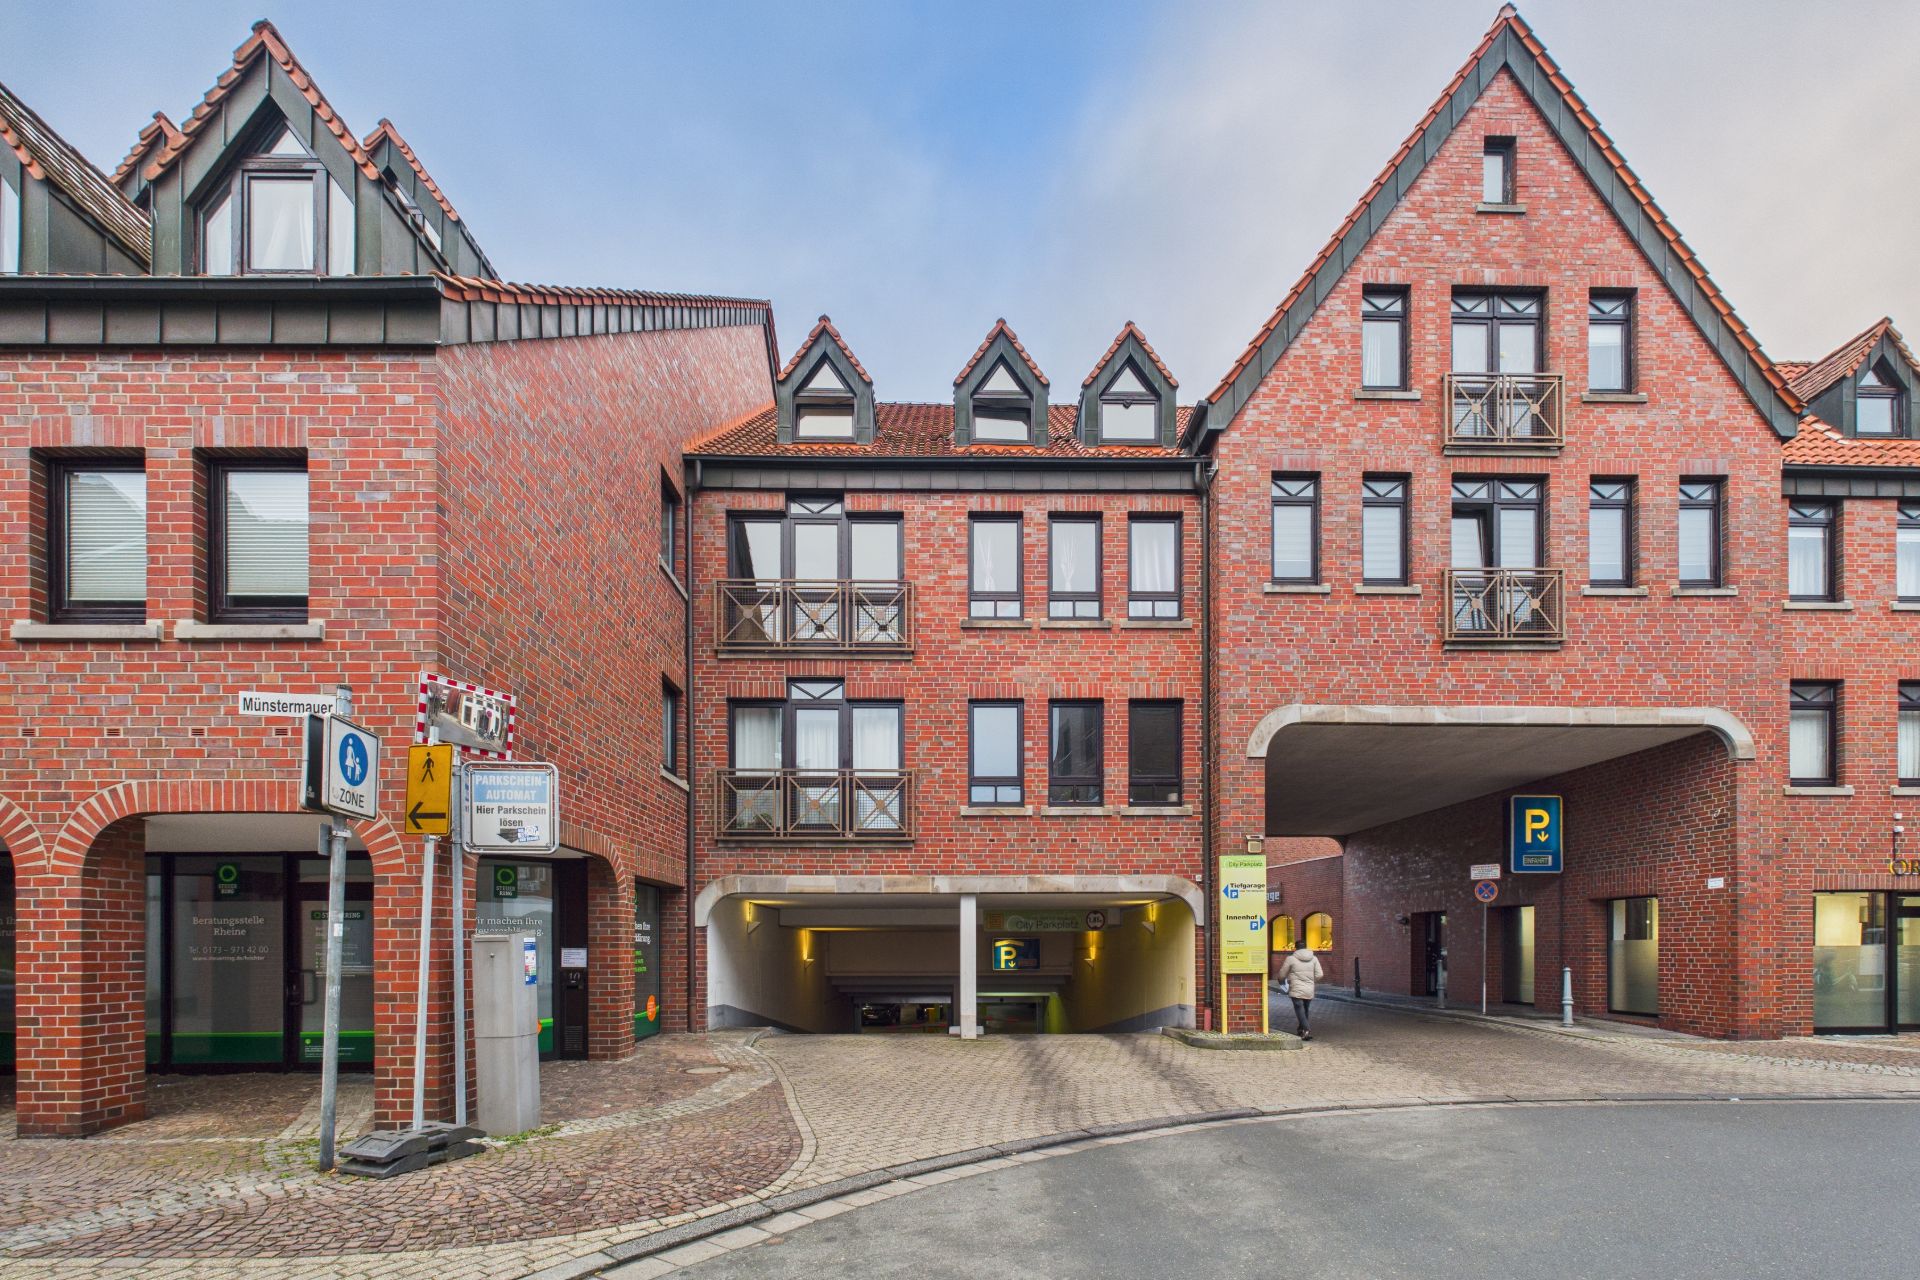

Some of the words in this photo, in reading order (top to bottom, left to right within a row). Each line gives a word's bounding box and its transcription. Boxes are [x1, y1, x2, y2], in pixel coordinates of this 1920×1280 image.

[243, 697, 333, 714] Münstermauer
[475, 775, 547, 787] PARKSCHEIN-
[339, 788, 365, 808] ZONE
[486, 789, 537, 801] AUTOMAT
[476, 806, 495, 815] Hier
[497, 806, 547, 815] Parkschein
[500, 817, 524, 827] lösen
[1525, 809, 1550, 844] P
[192, 915, 265, 927] Beratungsstelle
[486, 917, 523, 925] machen
[1015, 919, 1034, 931] City
[1036, 919, 1080, 930] Parkplatz
[213, 927, 247, 936] Rheine
[247, 946, 257, 954] 42
[258, 945, 270, 953] 00
[1000, 946, 1017, 969] P
